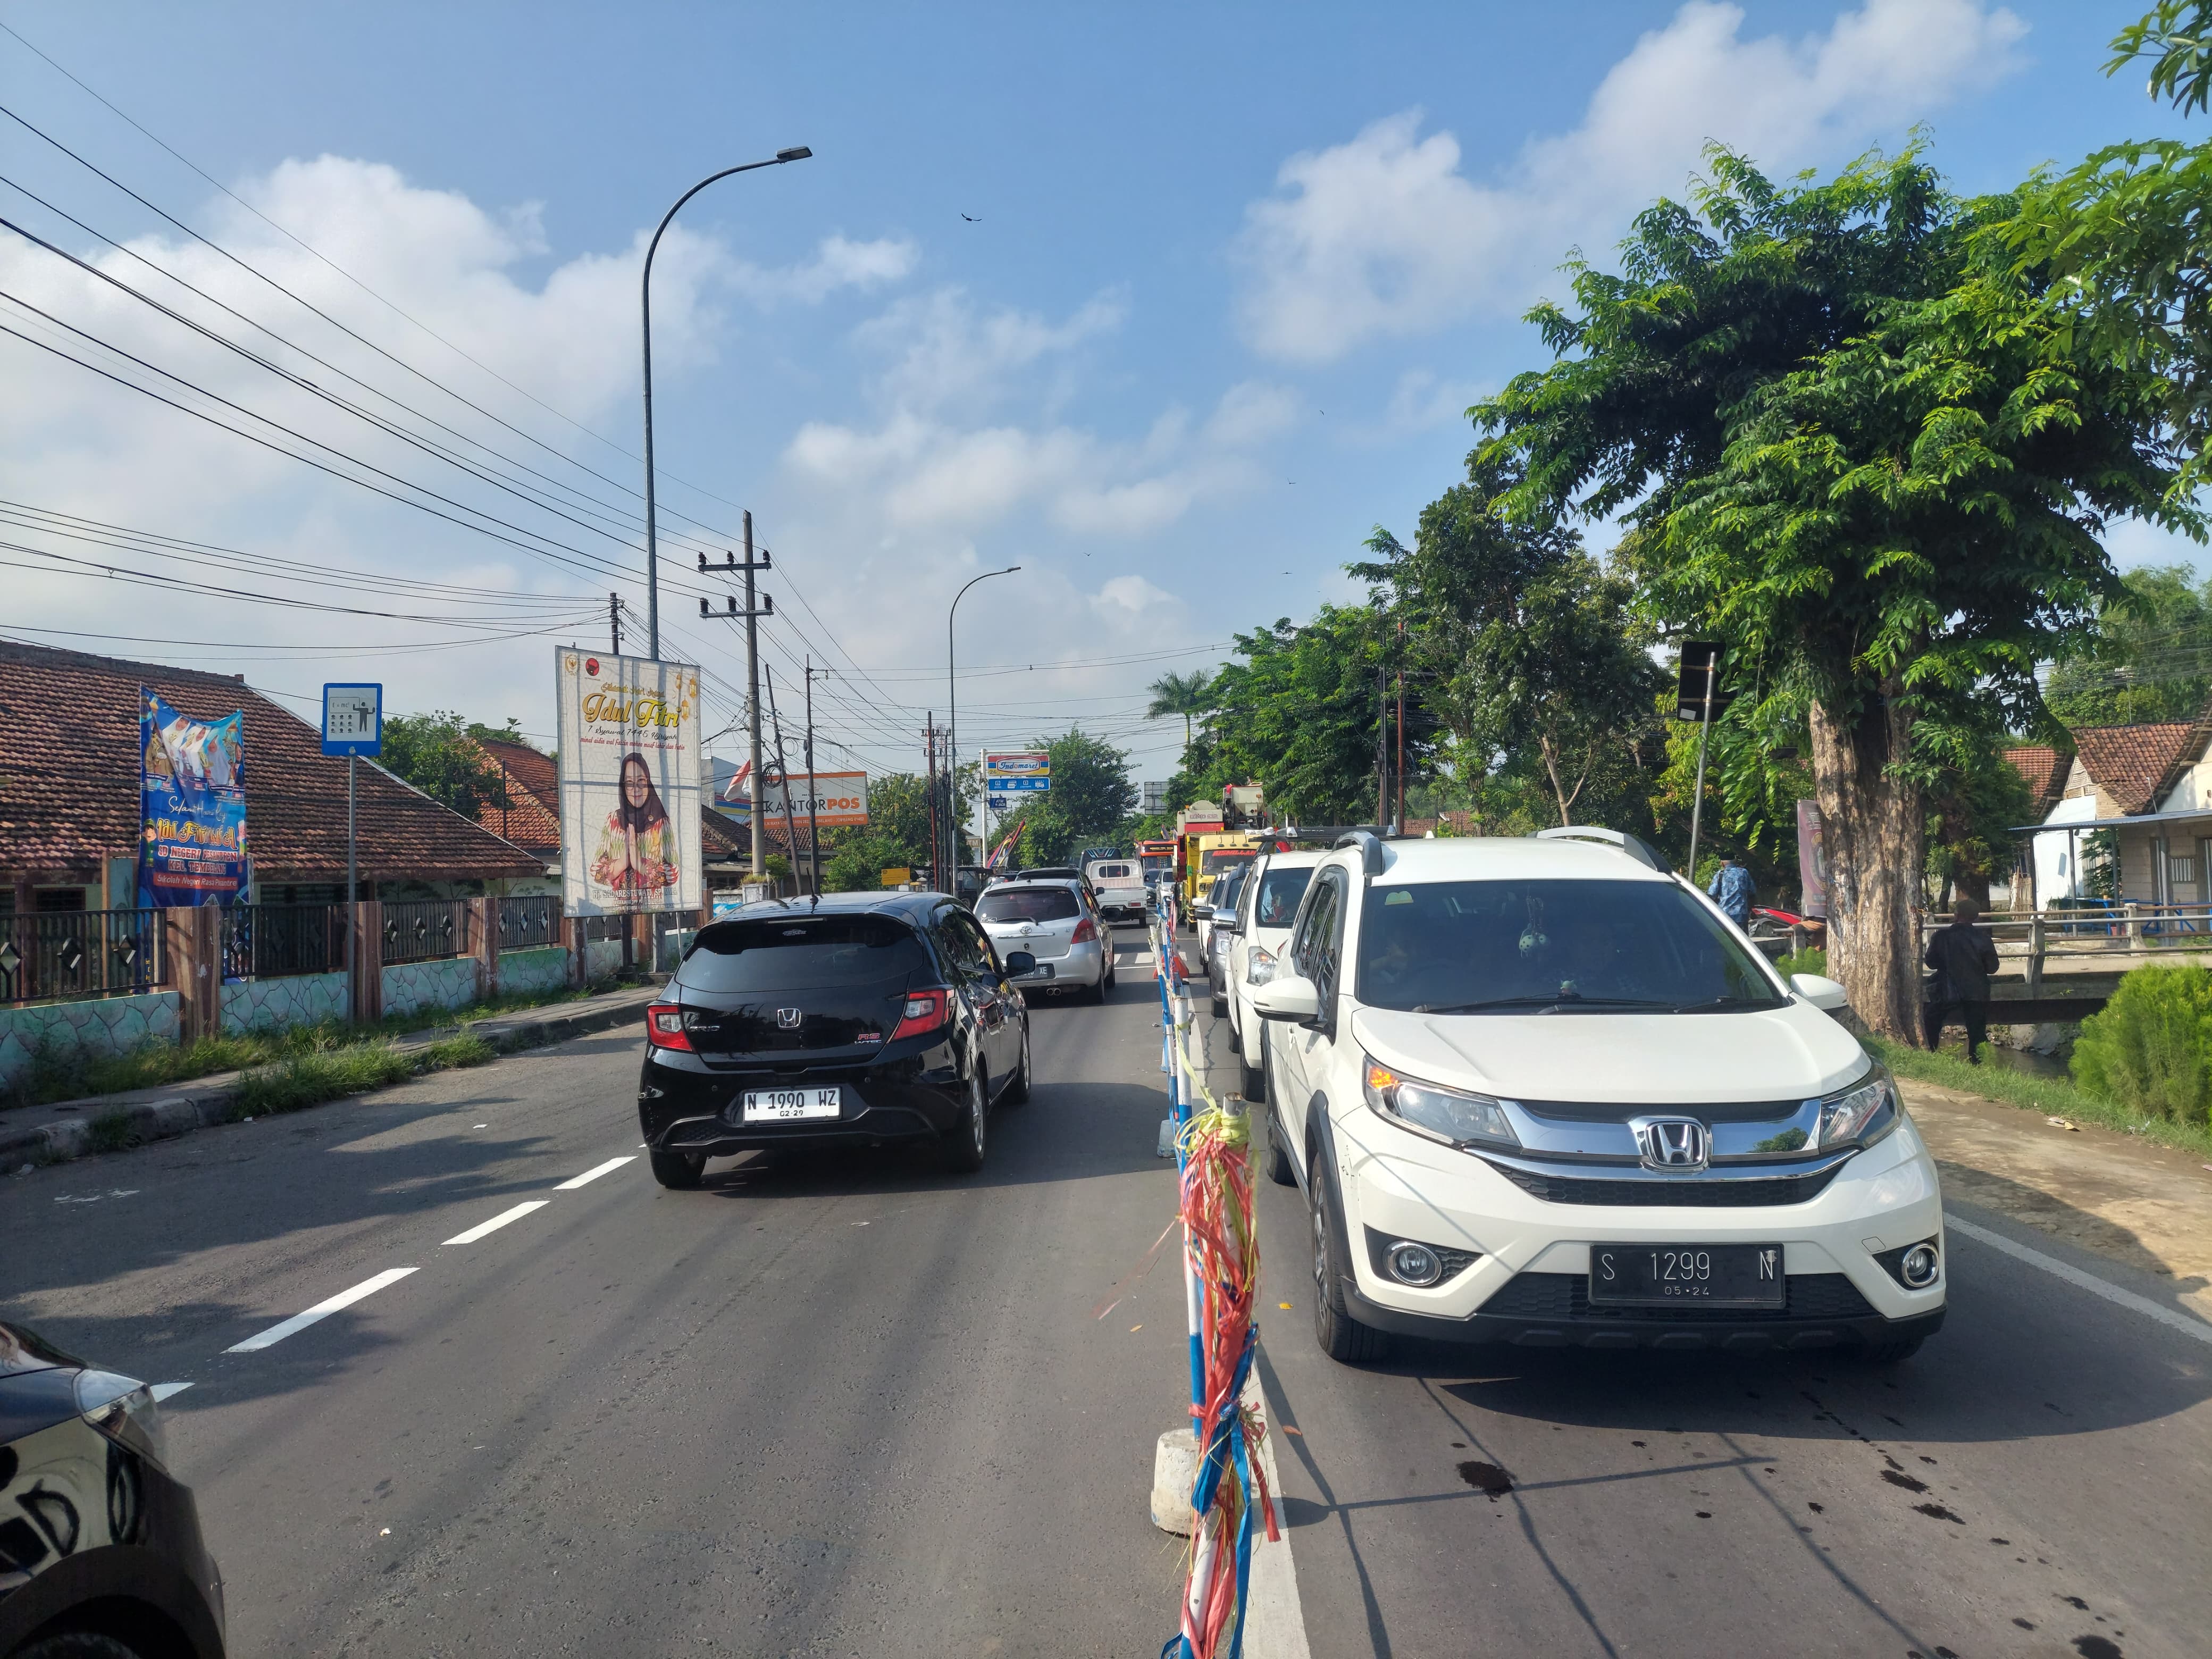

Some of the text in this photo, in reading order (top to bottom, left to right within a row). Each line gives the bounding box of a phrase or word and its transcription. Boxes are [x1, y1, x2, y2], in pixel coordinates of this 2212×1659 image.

[582, 693, 681, 727] Idul Fitri
[595, 726, 625, 735] Syawal
[158, 845, 169, 857] SD
[170, 846, 202, 860] NEGERI
[182, 877, 201, 886] Negeri
[748, 1091, 836, 1110] N 1990 WZ
[1602, 1251, 1774, 1280] S 1299 N
